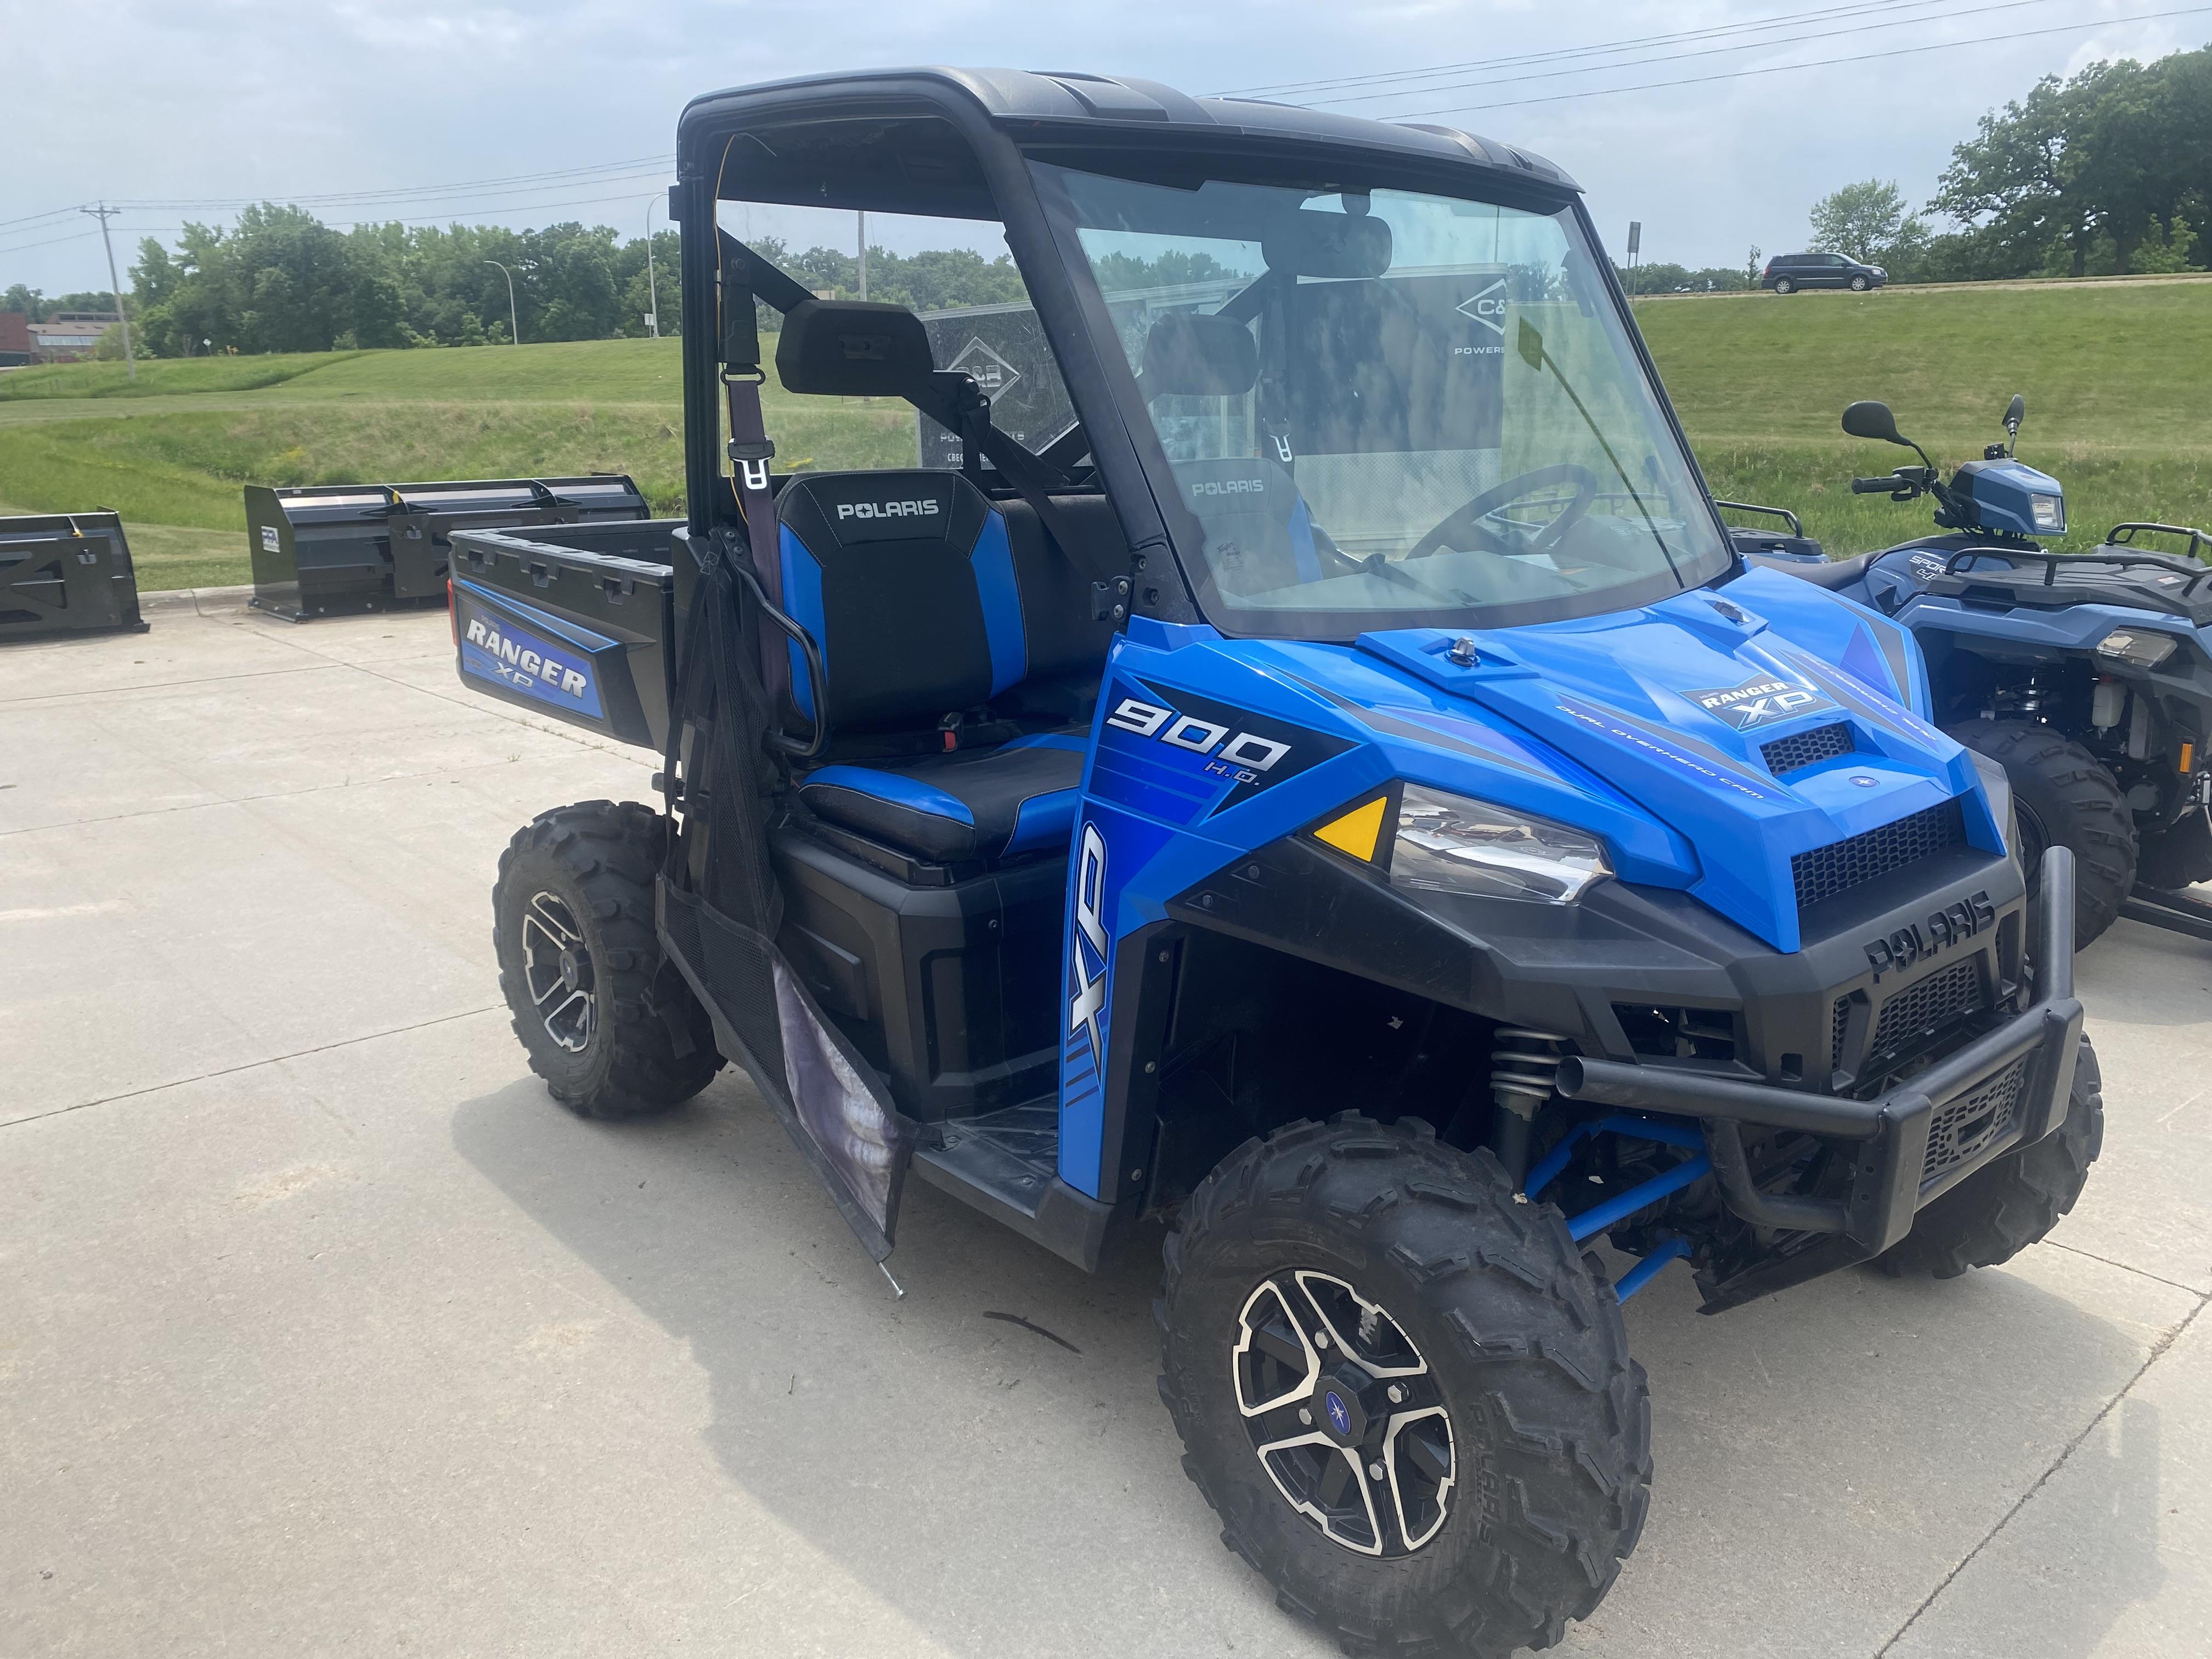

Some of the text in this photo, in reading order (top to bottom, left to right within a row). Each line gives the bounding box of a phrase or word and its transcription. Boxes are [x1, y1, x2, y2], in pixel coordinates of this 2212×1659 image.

[1455, 346, 1505, 354] POWERS
[1192, 479, 1264, 496] POLARIS
[837, 499, 939, 520] POLARIS
[1909, 555, 1947, 574] SPOR
[466, 619, 587, 698] RANGER
[490, 662, 534, 689] XP
[1701, 681, 1790, 709] RANGER
[1728, 690, 1815, 726] XP
[1106, 698, 1293, 772] 900
[1555, 705, 1765, 799] DUAL OVERHEAD CAM
[1203, 761, 1261, 786] H.O.
[1862, 890, 1995, 985] POLARIS
[1070, 822, 1108, 1084] XP
